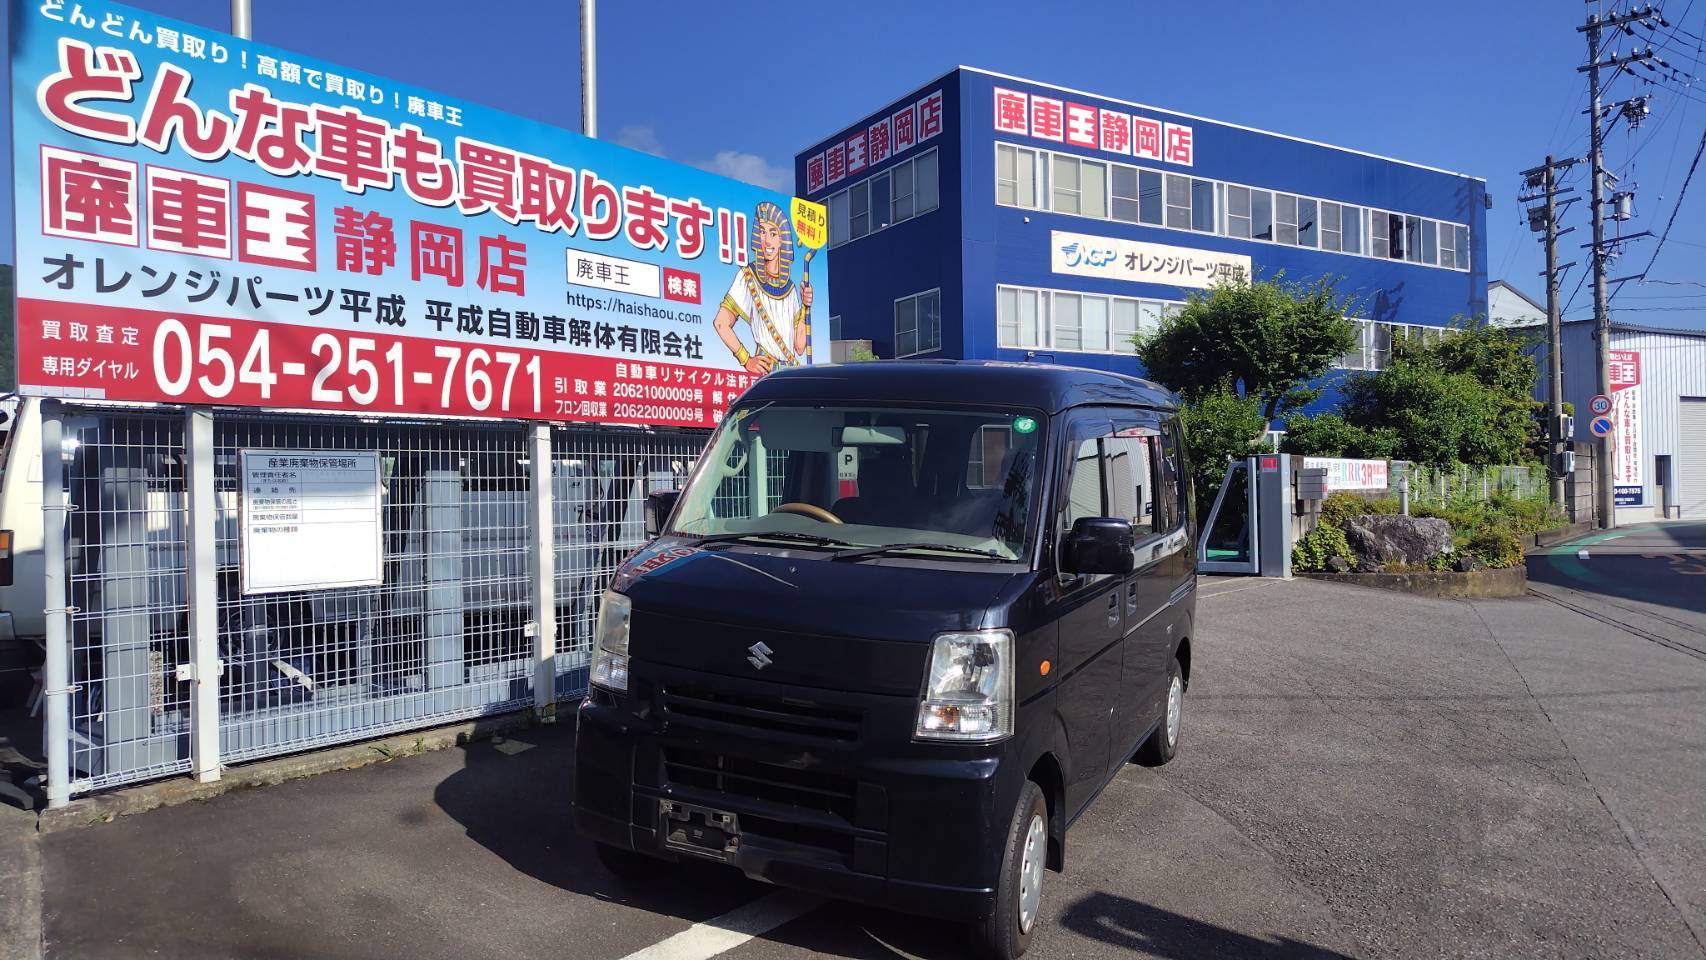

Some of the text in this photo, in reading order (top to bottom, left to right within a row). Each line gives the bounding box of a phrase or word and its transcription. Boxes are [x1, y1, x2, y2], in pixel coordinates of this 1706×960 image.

[994, 88, 1192, 165] 廃車王静岡店
[807, 91, 942, 193] 廃車王静岡店
[797, 202, 825, 227] 見積り
[576, 258, 630, 286] 廃車王
[667, 274, 698, 298] 検索
[42, 253, 704, 360] オレンジパーツ平成 平成自動車解体有限会社
[566, 291, 702, 324] https://haishaou.com
[42, 320, 139, 346] 買取査定
[42, 356, 139, 380] 専用ダイヤル
[153, 318, 542, 413] 054-251-7671
[554, 377, 607, 397] 引取業
[613, 382, 703, 404] 20621000009号
[554, 400, 607, 418] フロン回収業
[614, 403, 704, 423] 20622000009号
[1594, 401, 1608, 410] 30
[268, 457, 357, 468] 産業廃棄物保管場所
[845, 454, 852, 465] P
